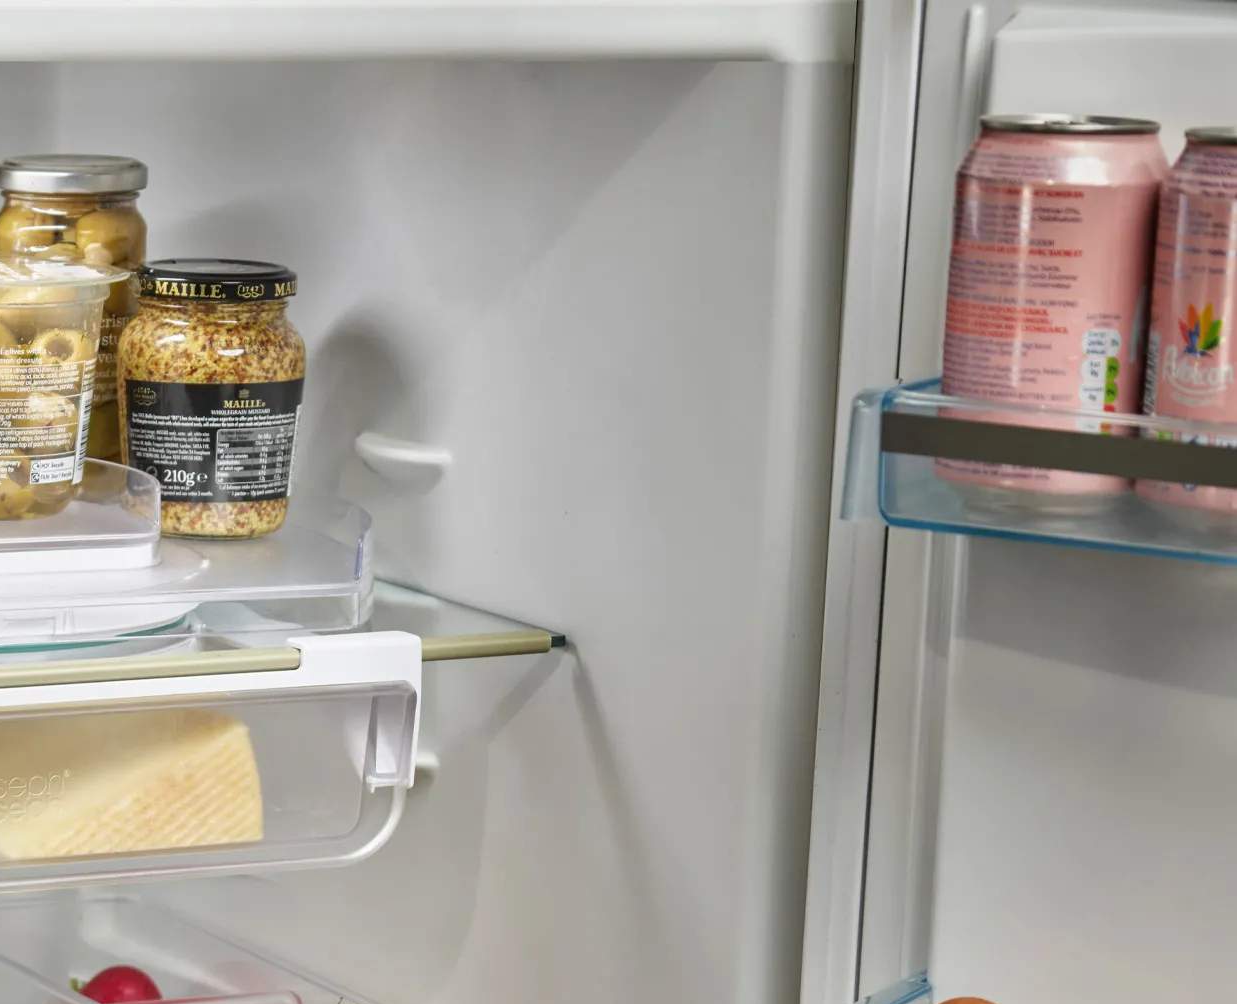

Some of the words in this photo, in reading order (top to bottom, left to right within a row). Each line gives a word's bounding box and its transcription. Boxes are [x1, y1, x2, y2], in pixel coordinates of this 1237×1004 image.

[155, 280, 222, 298] MAILLE
[224, 400, 262, 408] MAILLE
[164, 469, 196, 486] 210g
